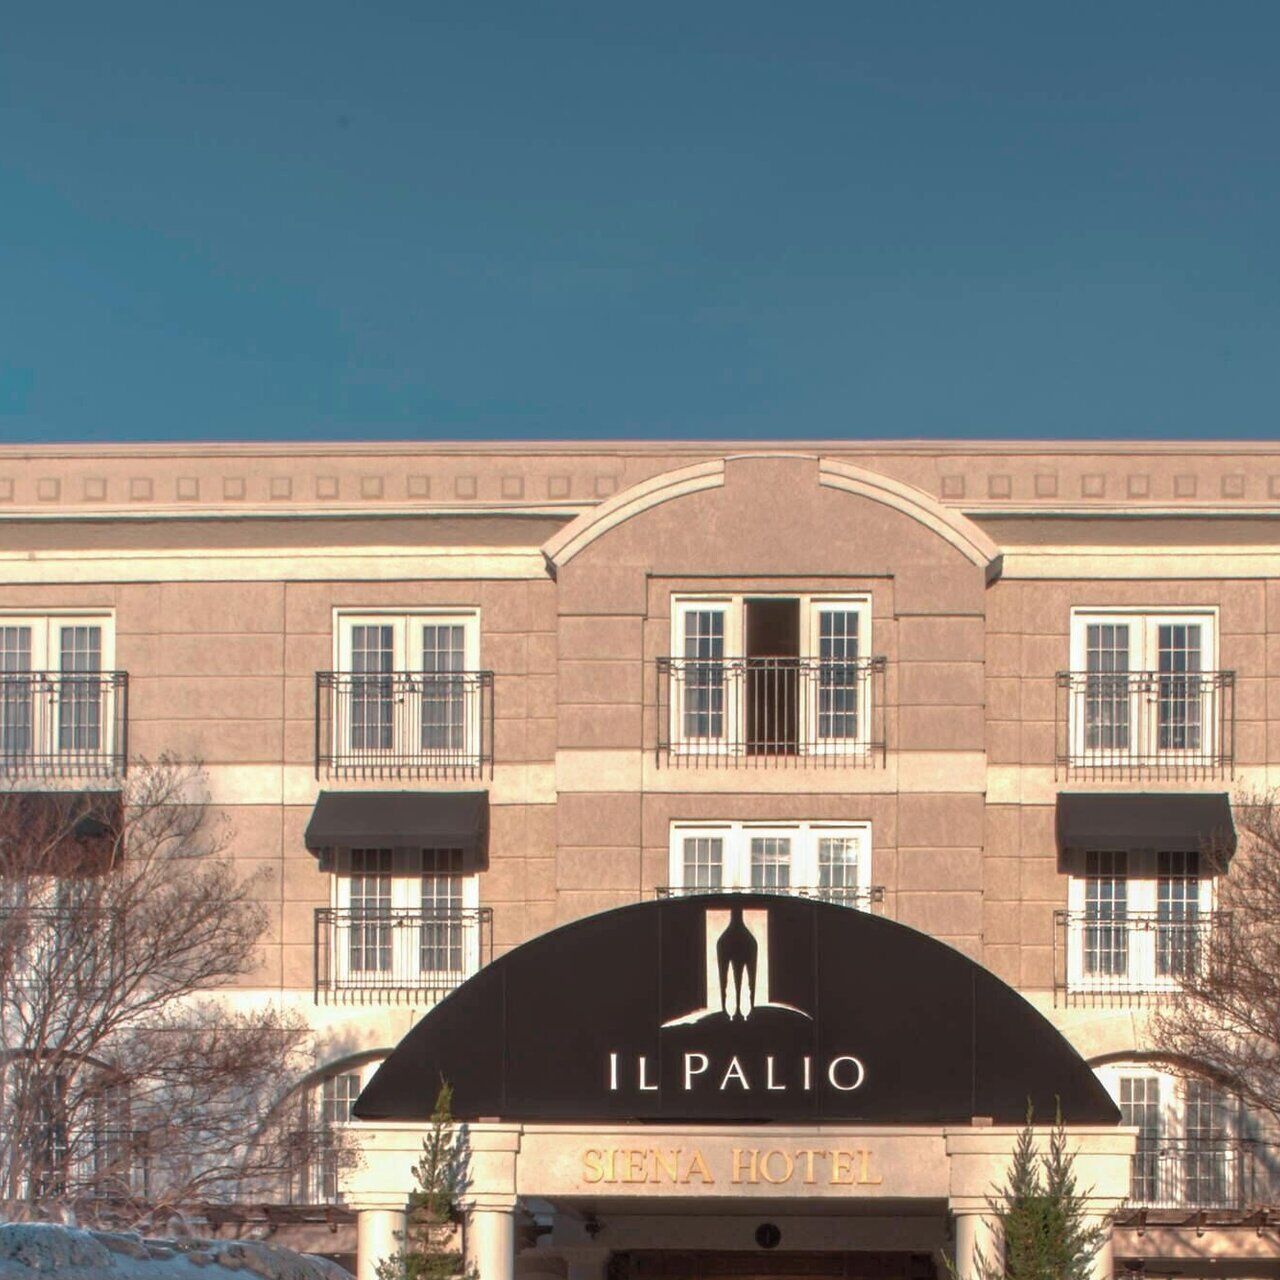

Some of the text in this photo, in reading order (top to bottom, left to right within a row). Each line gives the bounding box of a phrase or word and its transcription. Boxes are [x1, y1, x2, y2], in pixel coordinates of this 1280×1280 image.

[609, 1053, 865, 1091] IL PALIO
[582, 1149, 882, 1186] SIENA HOTEL
